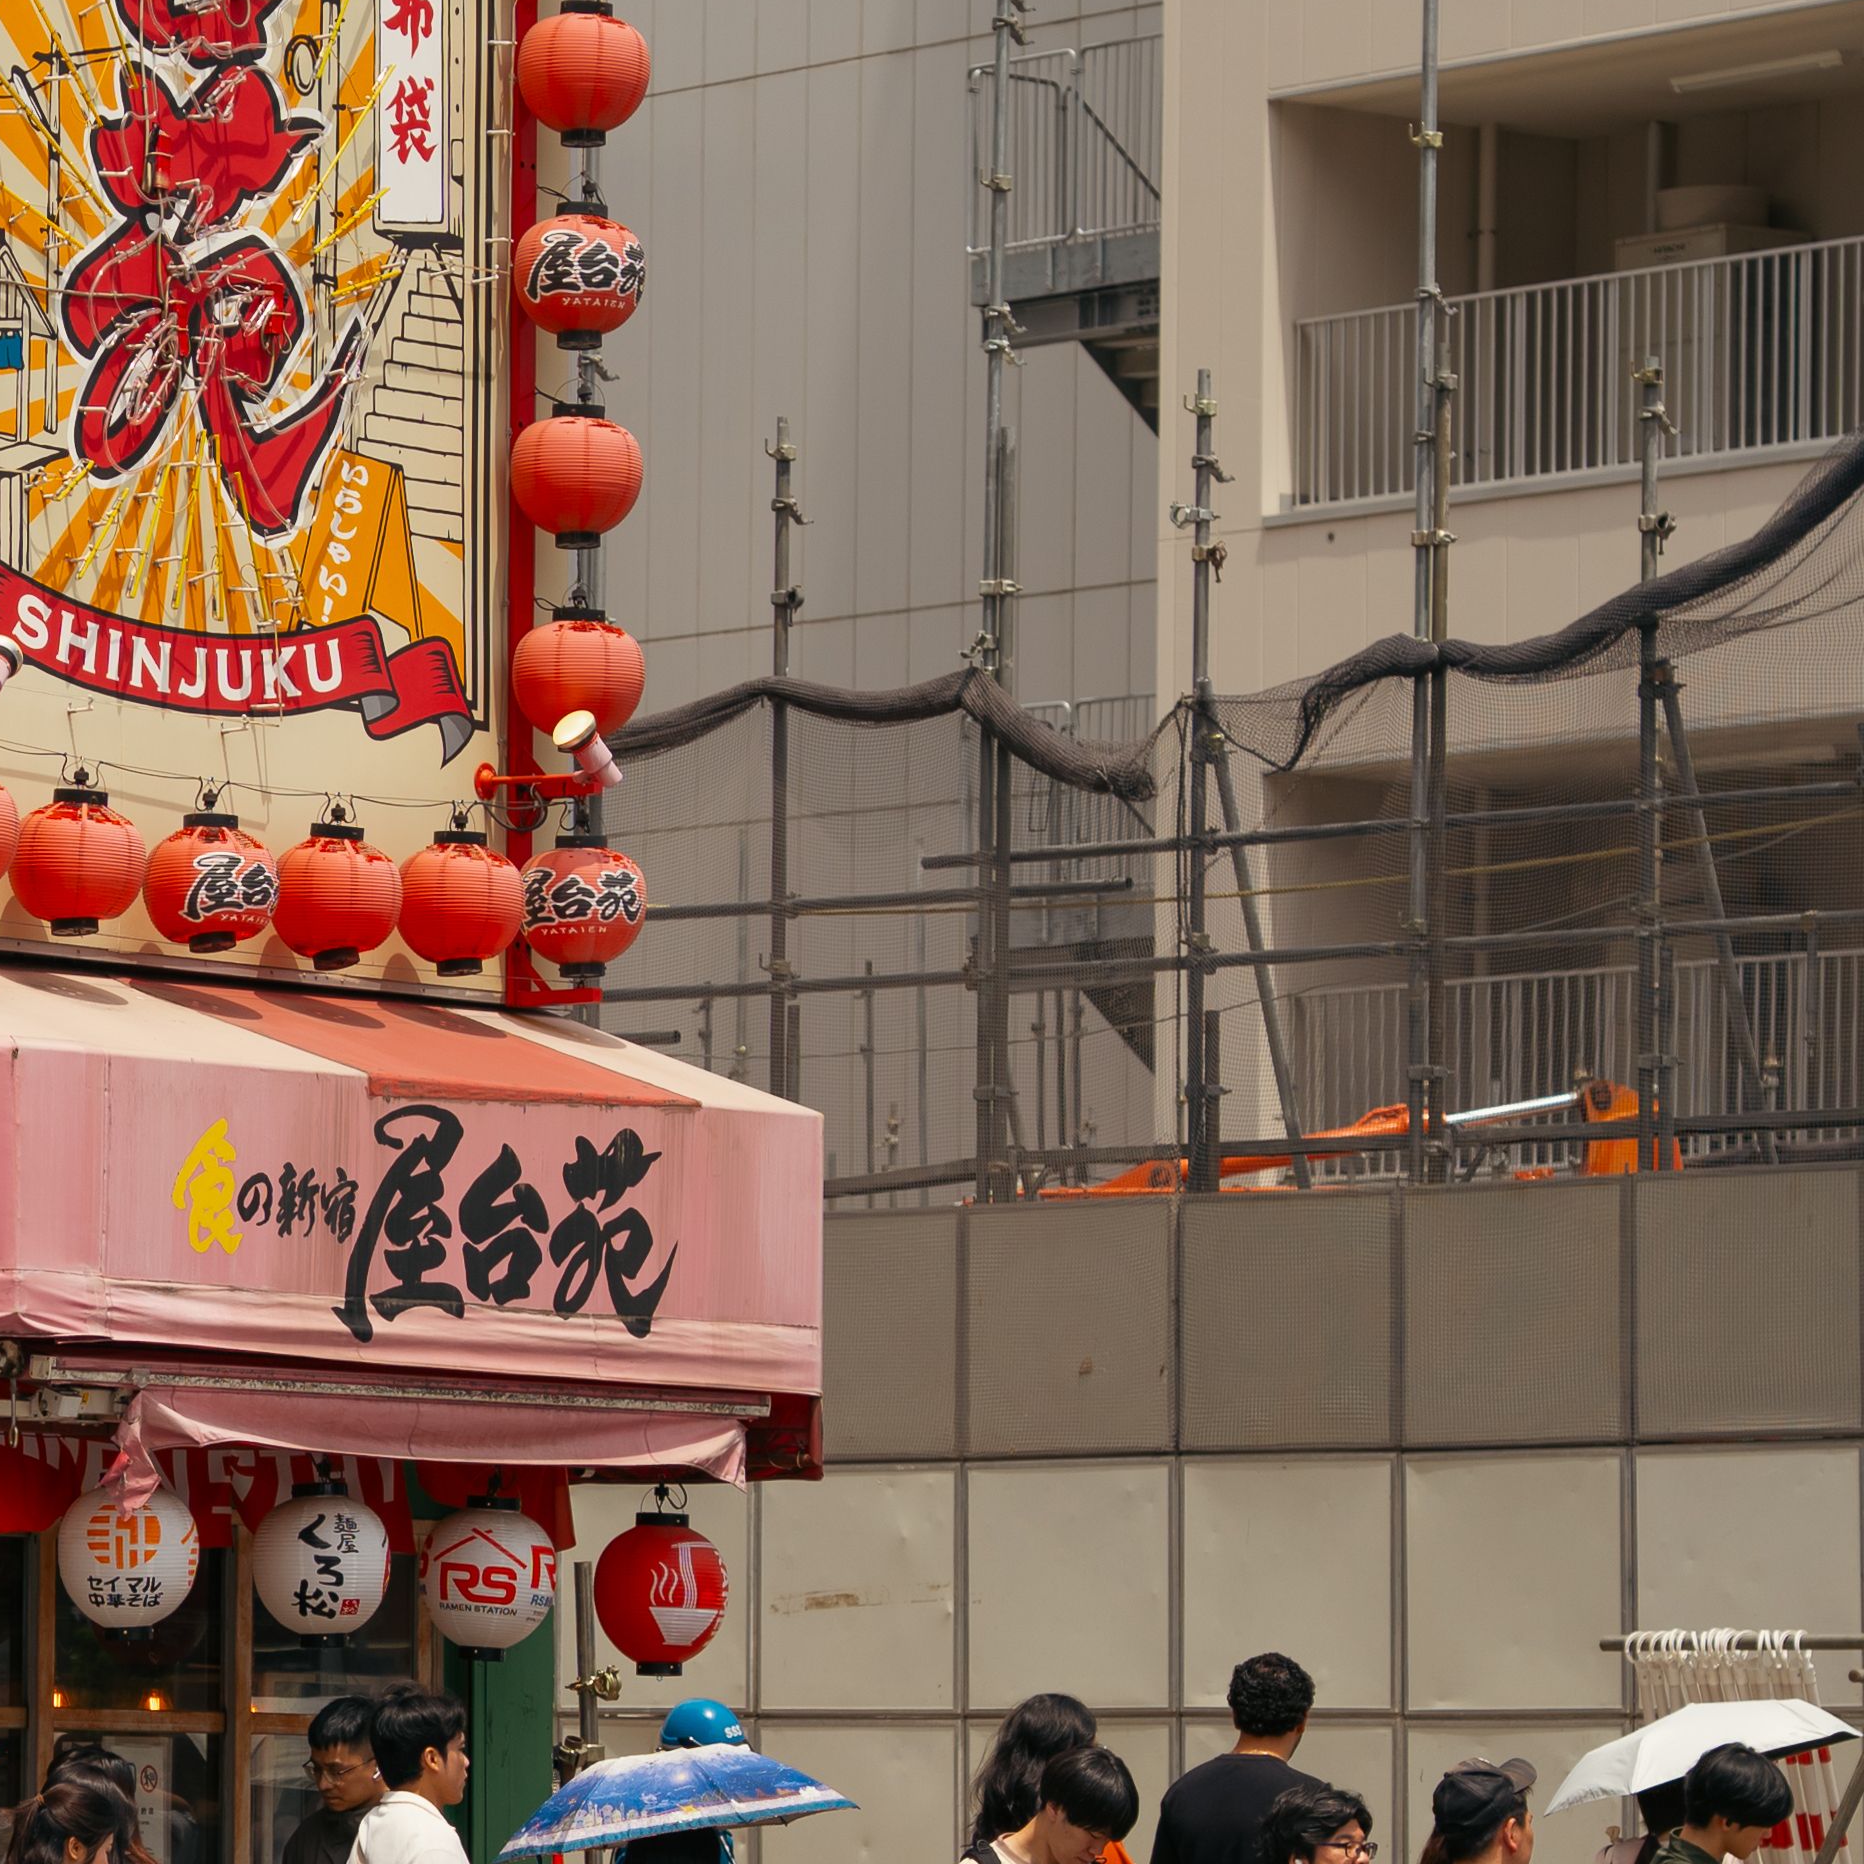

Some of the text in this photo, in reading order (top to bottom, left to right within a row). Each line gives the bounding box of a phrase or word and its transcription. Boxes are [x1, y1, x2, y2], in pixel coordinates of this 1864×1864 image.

[562, 296, 625, 310] YATAIEN
[11, 593, 343, 701] SHINJUKU
[180, 852, 278, 923] 屋台
[523, 868, 642, 927] 屋台苑
[541, 924, 607, 935] YATAIEN
[334, 1513, 360, 1553] 麺屋
[87, 1576, 161, 1592] セイマル
[292, 1513, 344, 1619] くろ松
[440, 1562, 517, 1605] RS
[89, 1593, 163, 1608] 中華そば
[439, 1602, 517, 1616] RAMEN STATION
